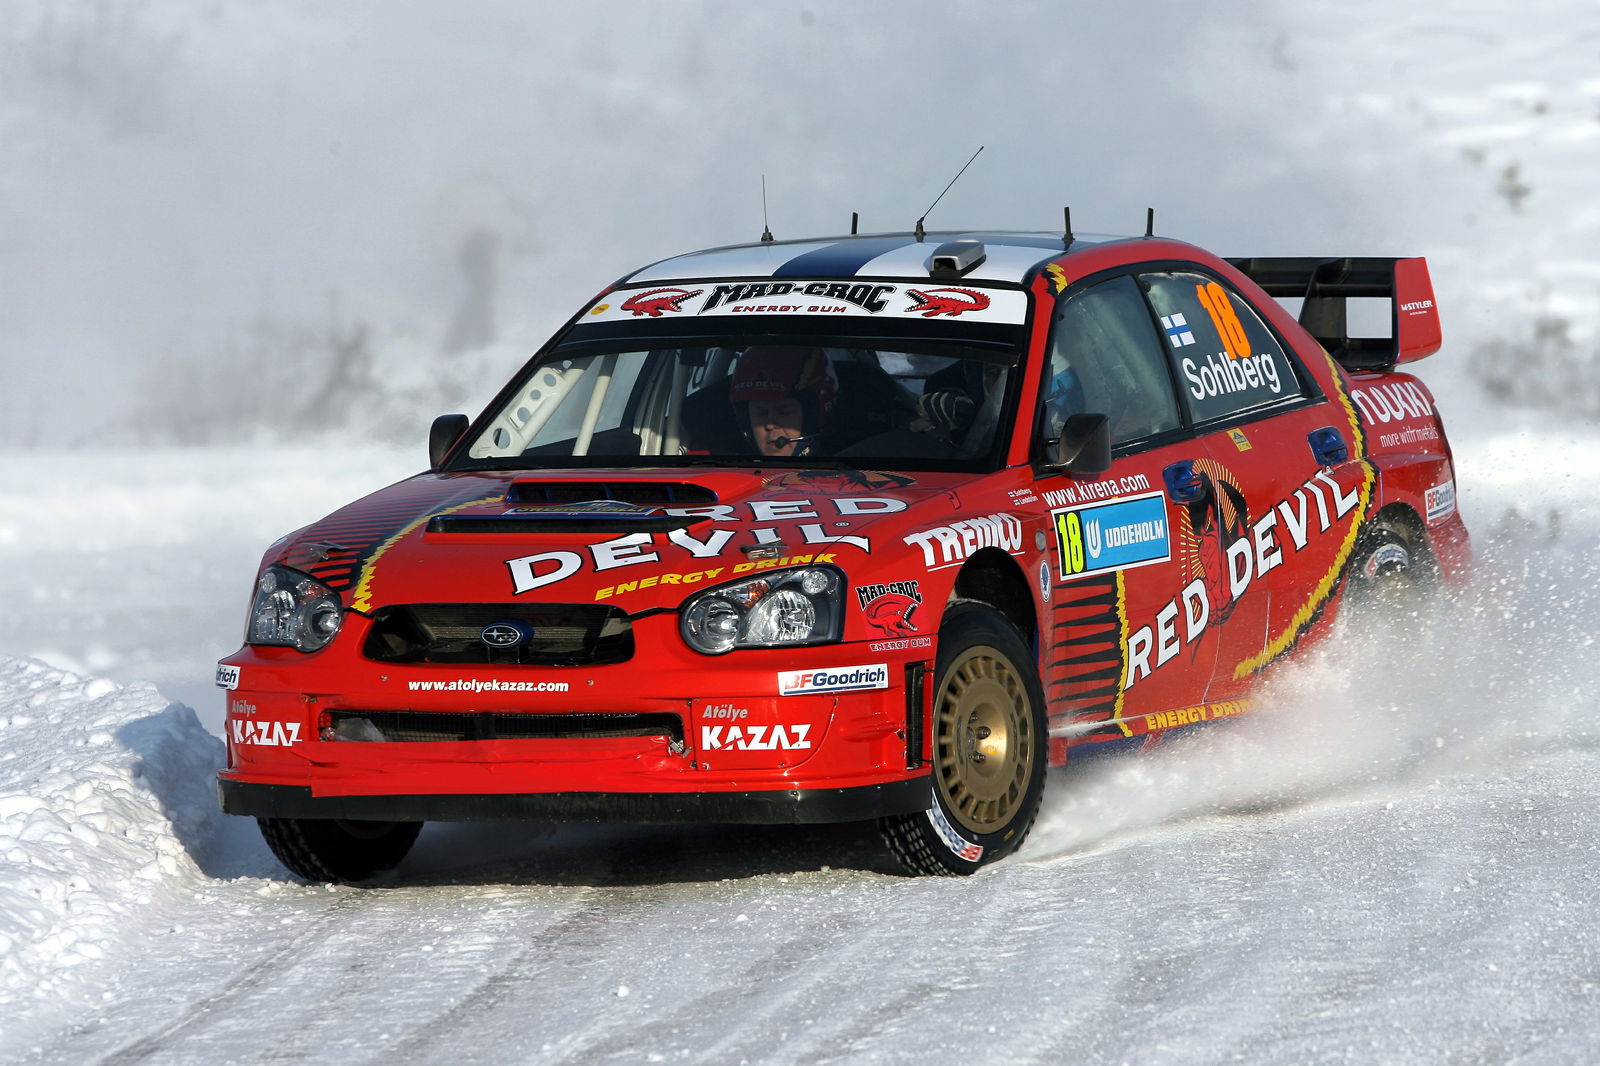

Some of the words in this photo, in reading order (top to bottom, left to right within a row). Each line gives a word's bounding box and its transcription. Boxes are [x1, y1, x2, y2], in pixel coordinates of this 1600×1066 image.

[698, 283, 897, 314] MAD-CROC
[732, 305, 802, 313] ENERGY
[1196, 282, 1251, 360] 18
[1182, 351, 1281, 400] Sohlberg
[1380, 432, 1400, 447] more
[1415, 422, 1439, 441] metals
[1042, 472, 1150, 507] www.kirena.com
[664, 497, 908, 523] RED
[903, 513, 1022, 567] TREMCO
[1058, 512, 1083, 574] 18
[1105, 519, 1165, 549] UDDEHOLM
[506, 524, 871, 594] DEVIL
[594, 566, 725, 600] ENERGY
[733, 553, 838, 575] DRINK
[1123, 578, 1210, 691] RED
[1226, 467, 1360, 601] DEVIL
[855, 580, 922, 611] MAD-CROC
[870, 640, 909, 652] ENERGY
[911, 638, 931, 648] GUM
[408, 678, 569, 693] www.atolyekazaz.com
[784, 667, 886, 690] BFGoodrich
[231, 699, 257, 717] Atölye
[702, 704, 748, 720] Atölye
[1144, 706, 1207, 730] ENERGY
[1209, 699, 1257, 718] DRIN
[232, 719, 303, 747] KAZAZ
[701, 724, 812, 750] KAZAZ
